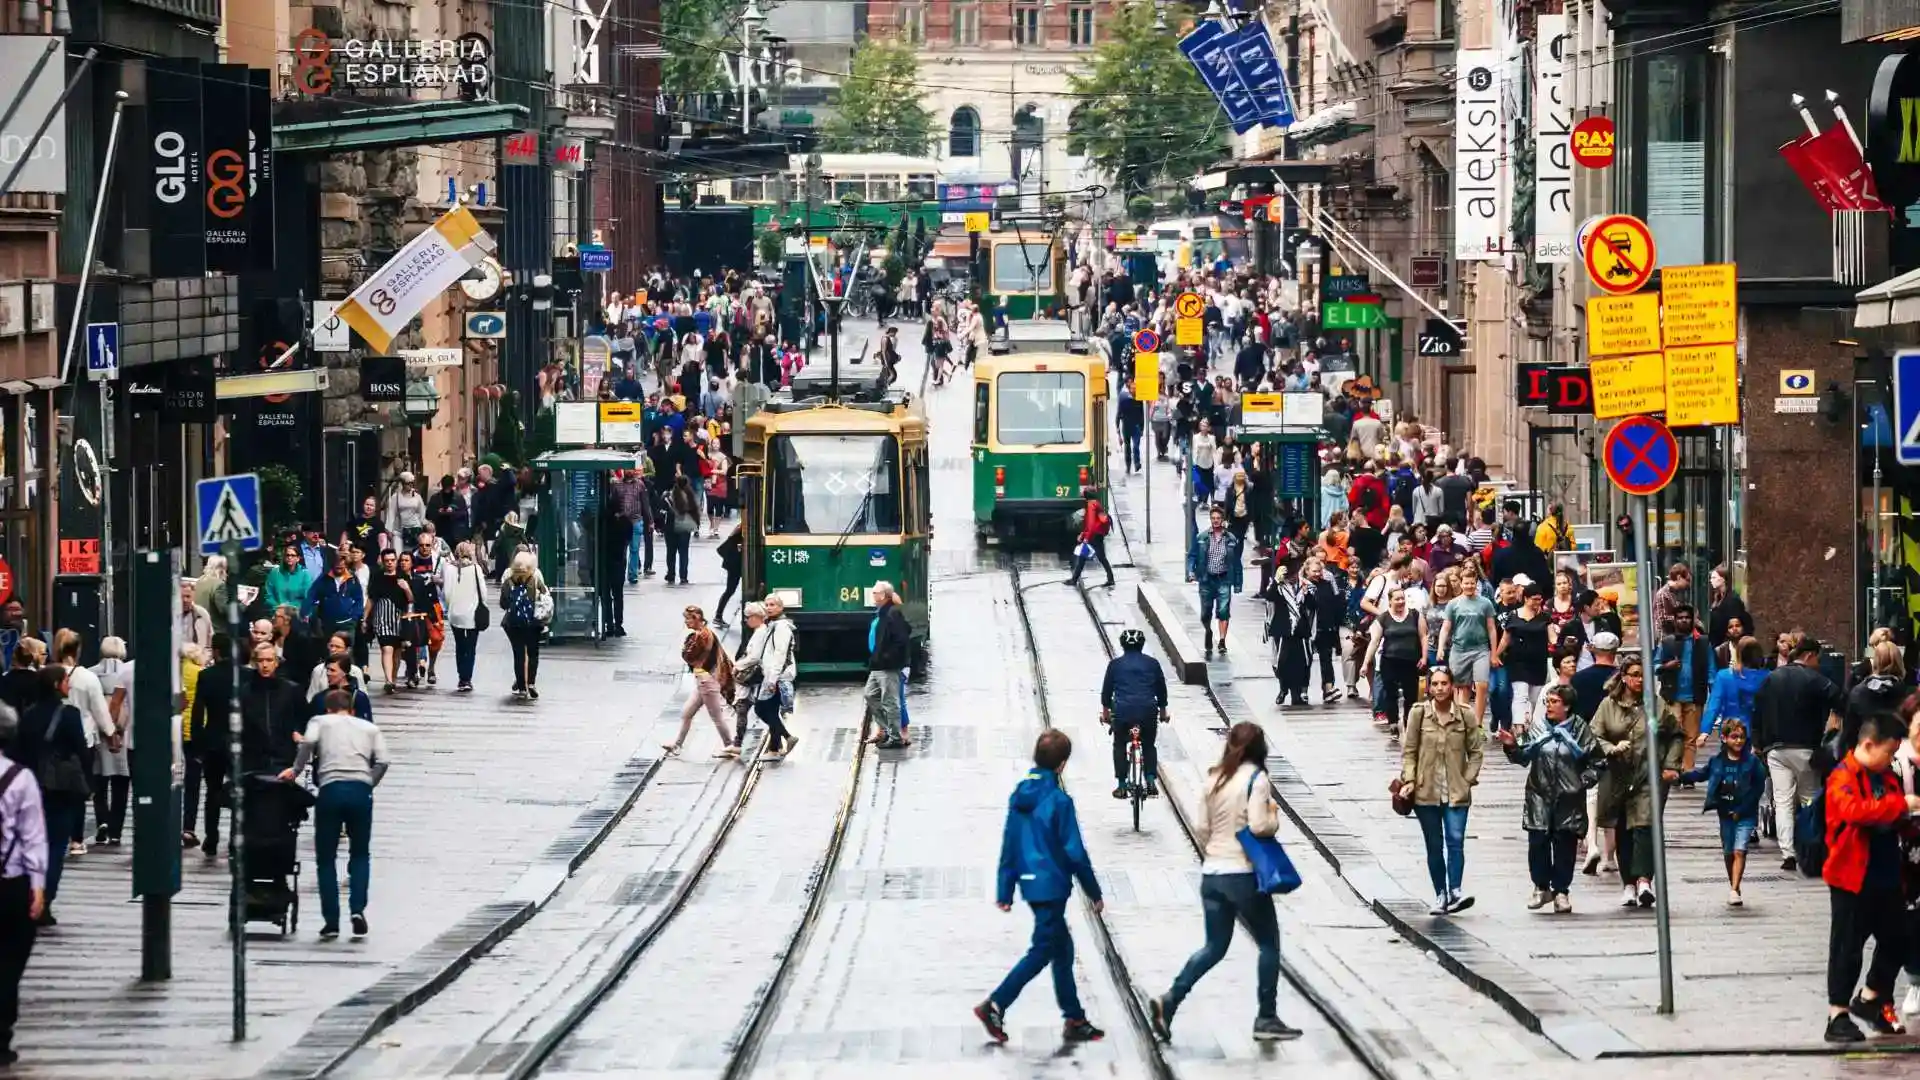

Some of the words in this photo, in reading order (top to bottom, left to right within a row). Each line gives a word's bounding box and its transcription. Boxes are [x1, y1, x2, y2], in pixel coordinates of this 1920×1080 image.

[345, 39, 486, 58] GALLERIA
[346, 64, 488, 83] ESPLANAD
[154, 131, 186, 203] GLO
[191, 151, 199, 182] HOTEL
[1458, 99, 1497, 218] aleksi
[206, 229, 247, 237] GALLERIA
[206, 236, 247, 244] ESPLANAD
[386, 240, 442, 288] GALLERIA
[392, 247, 446, 295] ESPLANAD
[1420, 336, 1451, 353] Zio
[370, 383, 400, 392] BOSS
[1557, 376, 1588, 407] D
[1055, 486, 1071, 497] 97
[840, 587, 860, 601] 84
